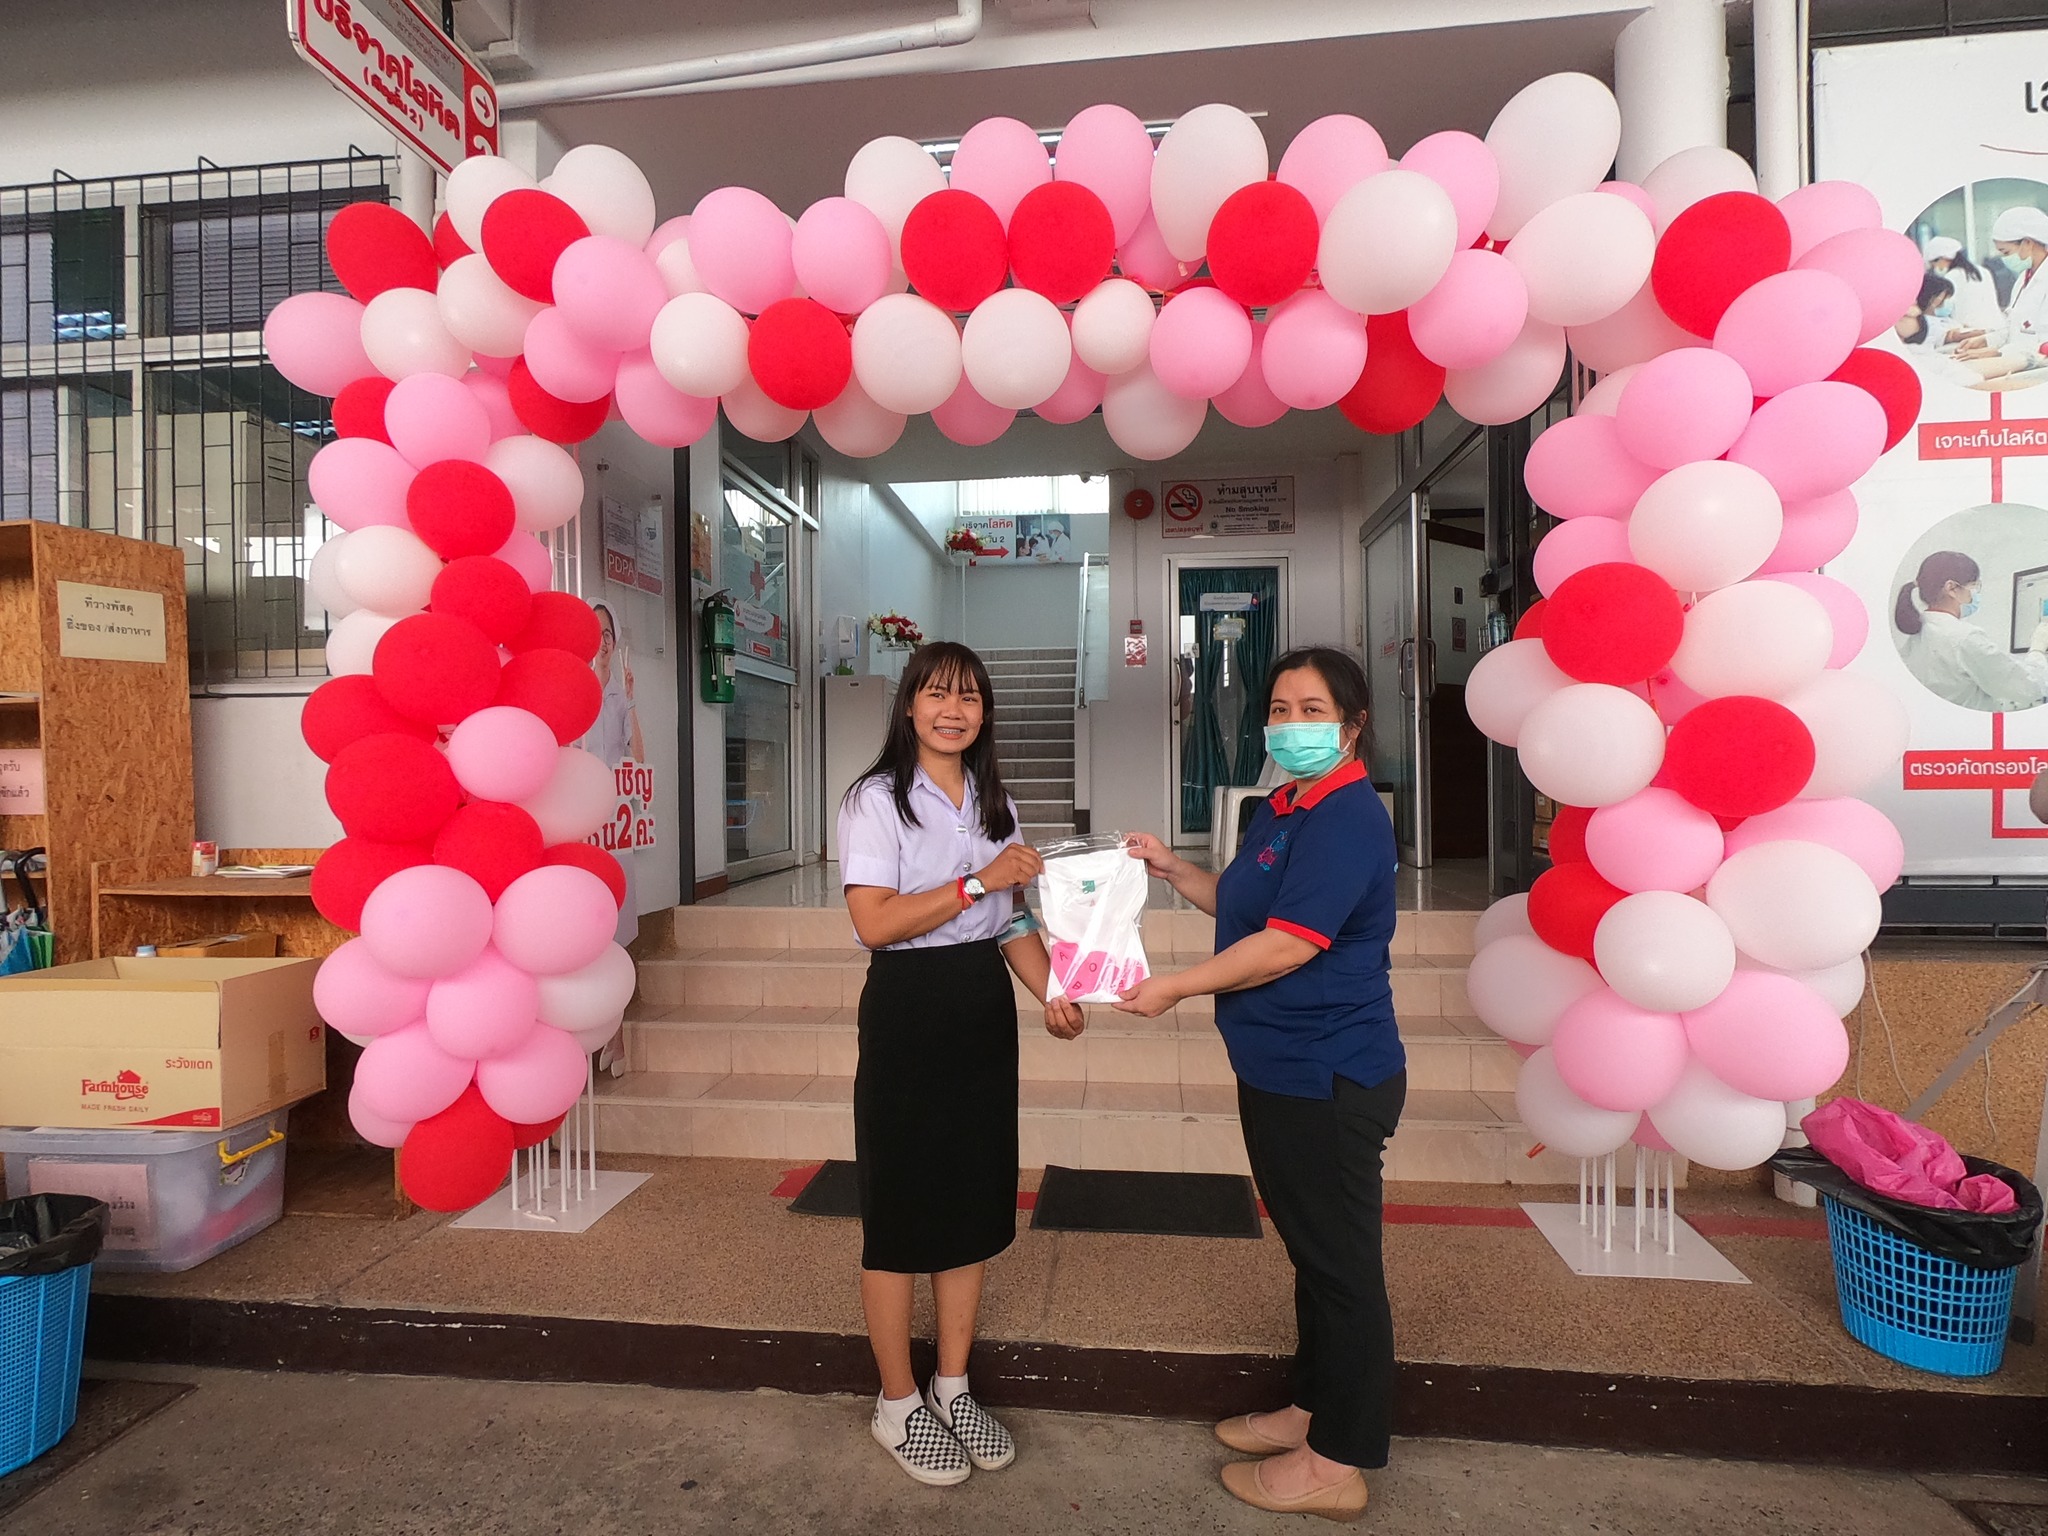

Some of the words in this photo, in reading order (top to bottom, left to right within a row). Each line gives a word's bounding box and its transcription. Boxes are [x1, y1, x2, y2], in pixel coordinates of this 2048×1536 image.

[1935, 428, 2048, 449] เจาะเก็บโลหิต
[1217, 480, 1279, 499] ห้ามสูบบุหรี่
[1225, 505, 1236, 513] No
[1239, 504, 1270, 513] Smoking
[999, 535, 1006, 544] 2
[608, 553, 635, 578] PDPA
[84, 594, 135, 616] ที่วางพัสดุ
[614, 761, 654, 803] เชิญ
[165, 1057, 213, 1070] ระวังแตก
[81, 1078, 149, 1101] Farmhouse
[80, 1103, 101, 1111] MADE
[103, 1104, 126, 1112] FRESH
[128, 1105, 149, 1113] DAILY
